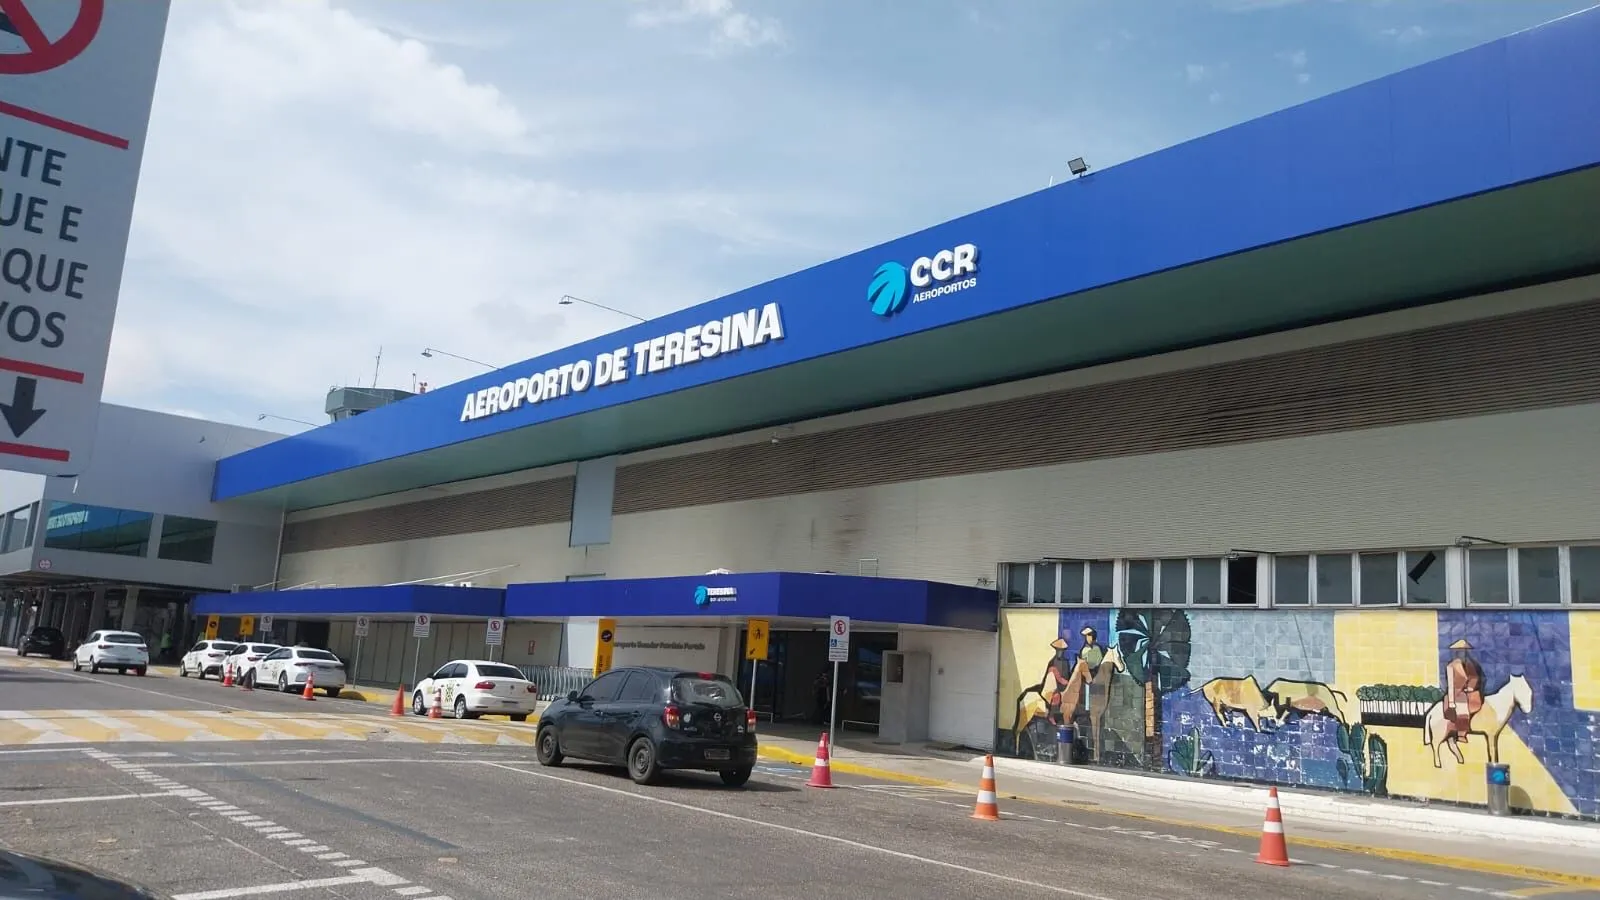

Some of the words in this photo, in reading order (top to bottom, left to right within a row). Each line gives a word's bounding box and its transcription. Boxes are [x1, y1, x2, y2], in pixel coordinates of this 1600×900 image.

[60, 205, 83, 243] E
[0, 248, 88, 300] QUE
[910, 243, 977, 287] CCR
[912, 277, 977, 304] AEROPORTOS
[460, 360, 592, 422] AEROPORTO
[594, 347, 629, 387] DE
[634, 302, 784, 375] TERESINA
